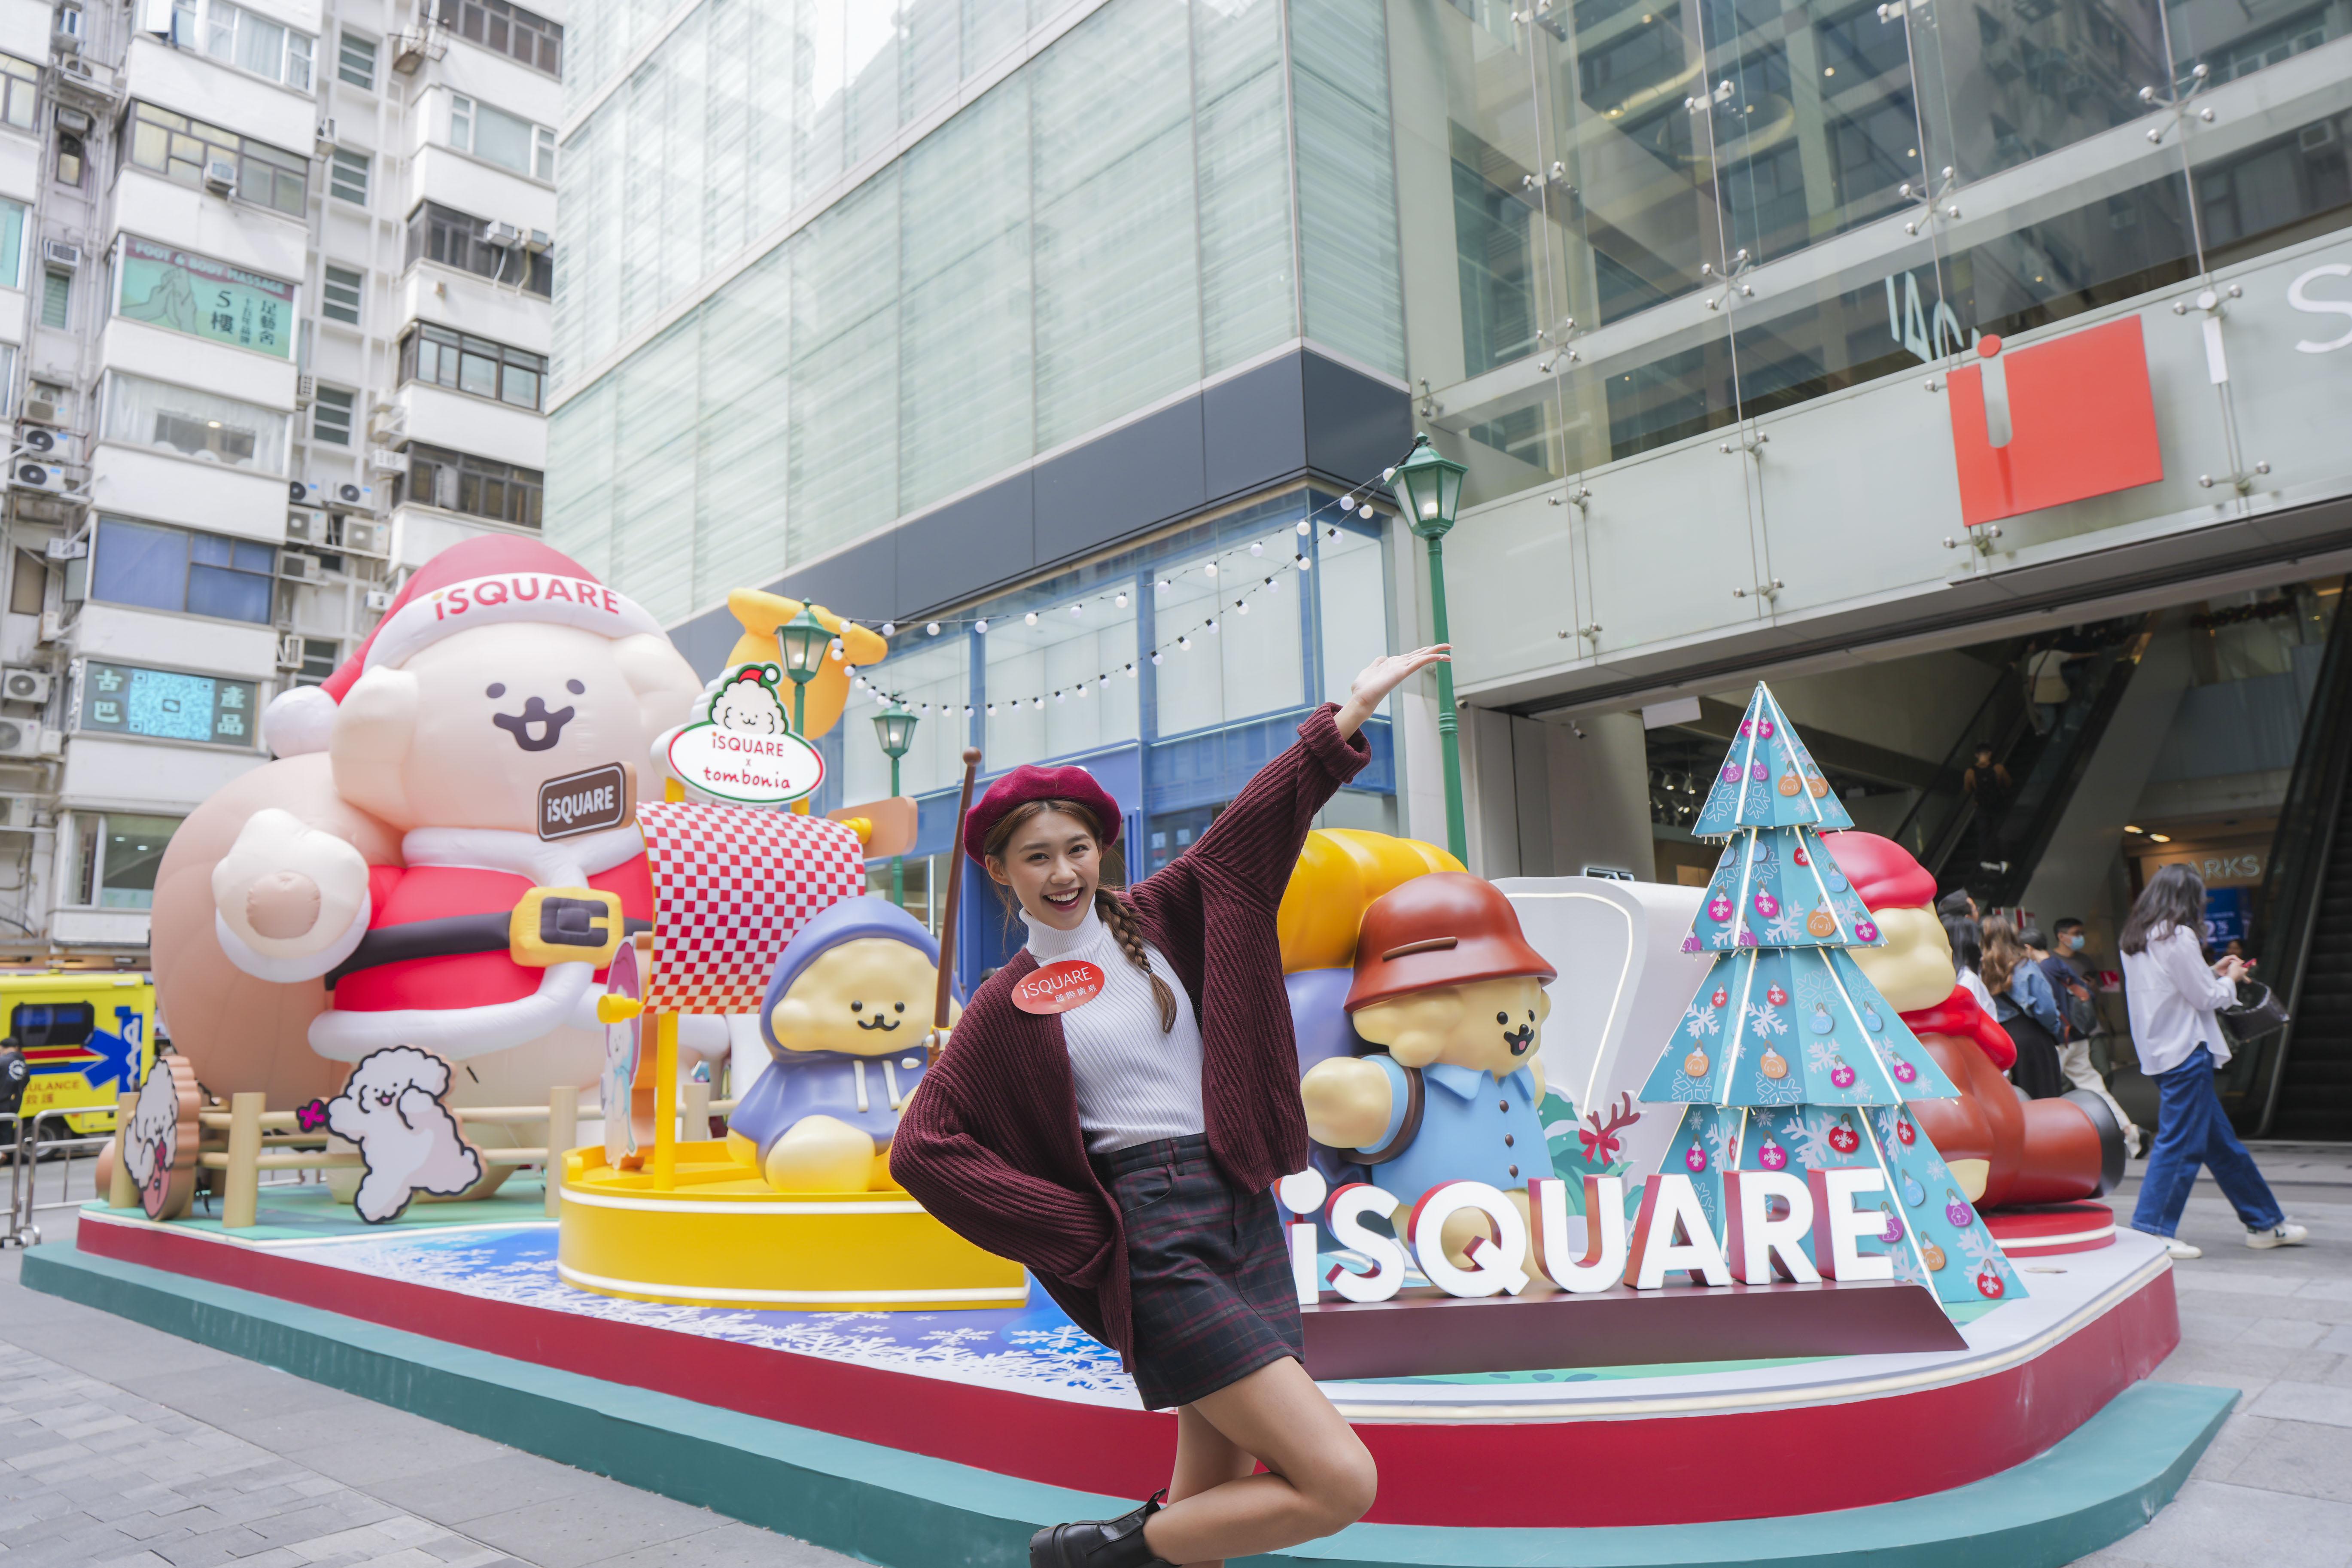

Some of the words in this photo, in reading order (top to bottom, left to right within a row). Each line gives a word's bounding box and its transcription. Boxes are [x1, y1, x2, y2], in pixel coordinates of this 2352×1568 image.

[136, 242, 171, 261] FOOT
[175, 253, 185, 265] &
[189, 258, 225, 277] BODY
[228, 268, 285, 295] MASSAGE
[432, 578, 619, 621] iSQUARE
[94, 669, 123, 723] 古巴
[217, 686, 246, 735] 產品
[712, 731, 783, 757] iSQUARE
[703, 767, 791, 789] tombonia
[547, 785, 615, 824] iSQUARE
[1021, 967, 1093, 999] iSQUARE
[1055, 984, 1097, 1002] 國際廣場
[24, 1080, 79, 1091] ULANCE
[1275, 1167, 1894, 1304] iSQUARE
